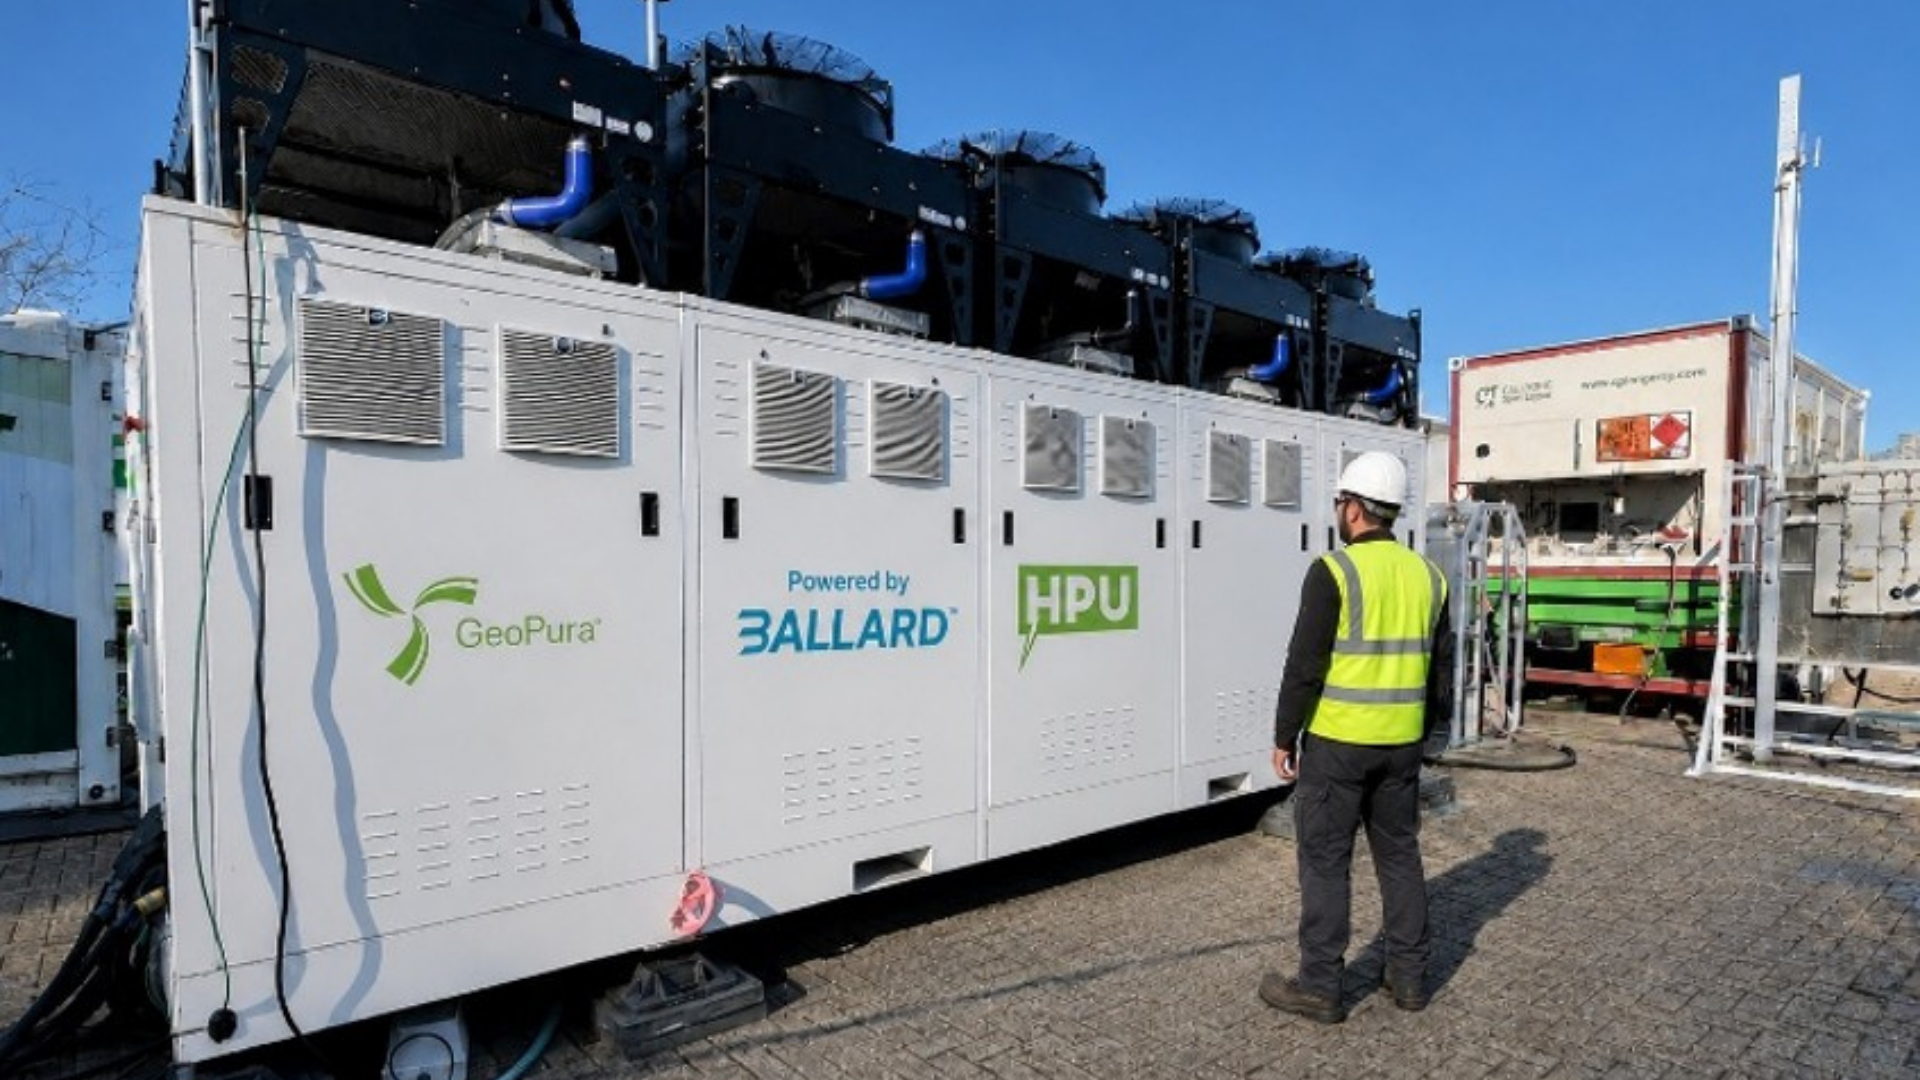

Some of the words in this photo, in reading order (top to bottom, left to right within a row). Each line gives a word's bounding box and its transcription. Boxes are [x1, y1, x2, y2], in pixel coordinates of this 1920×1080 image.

[788, 569, 880, 592] Powered
[885, 570, 910, 596] by
[1026, 575, 1131, 625] HPU
[455, 614, 597, 649] GeoPura
[738, 607, 949, 656] BALLARD
